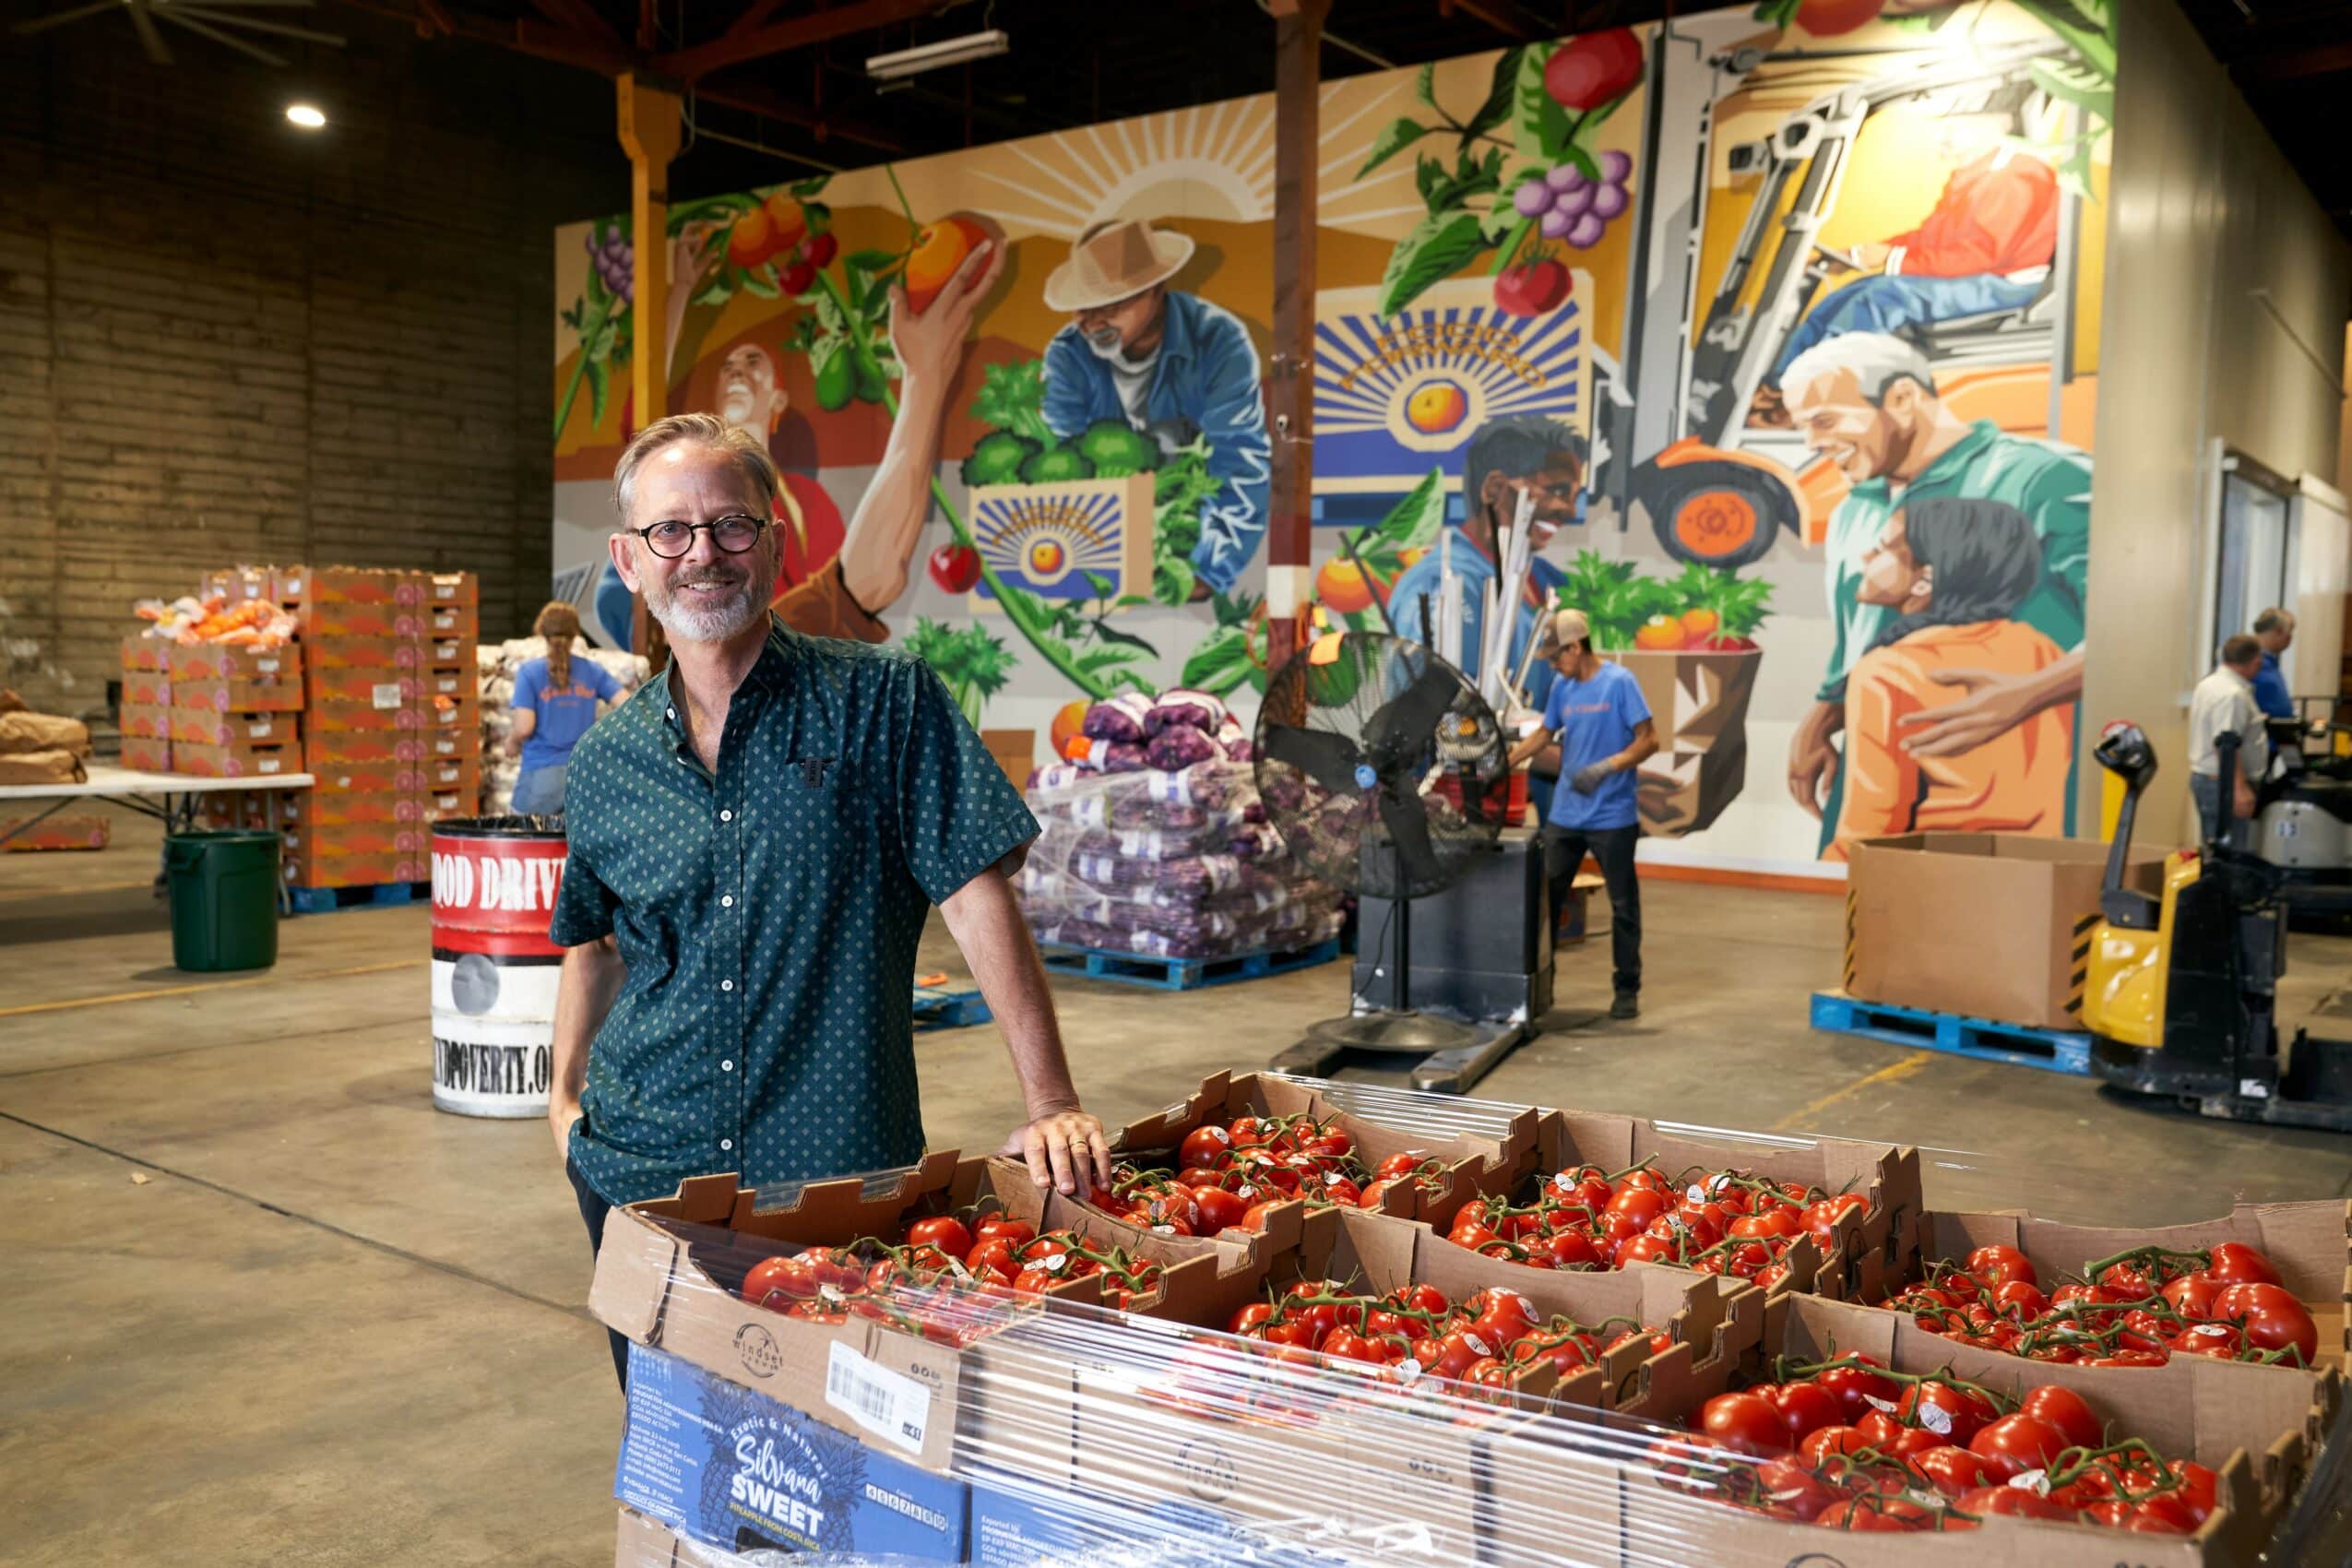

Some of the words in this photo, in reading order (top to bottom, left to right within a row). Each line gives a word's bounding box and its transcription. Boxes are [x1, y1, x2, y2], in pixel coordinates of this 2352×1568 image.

[1337, 340, 1549, 391] FORWARD
[1375, 322, 1522, 354] FOOD
[432, 852, 474, 909] OOD
[434, 1037, 553, 1095] NDPOVERTY.O
[730, 1415, 766, 1442] Exotic
[768, 1417, 778, 1431] &
[783, 1423, 830, 1480] Natural
[735, 1433, 824, 1503] Silvana
[730, 1473, 825, 1537] SWEET
[764, 1518, 783, 1535] FROM
